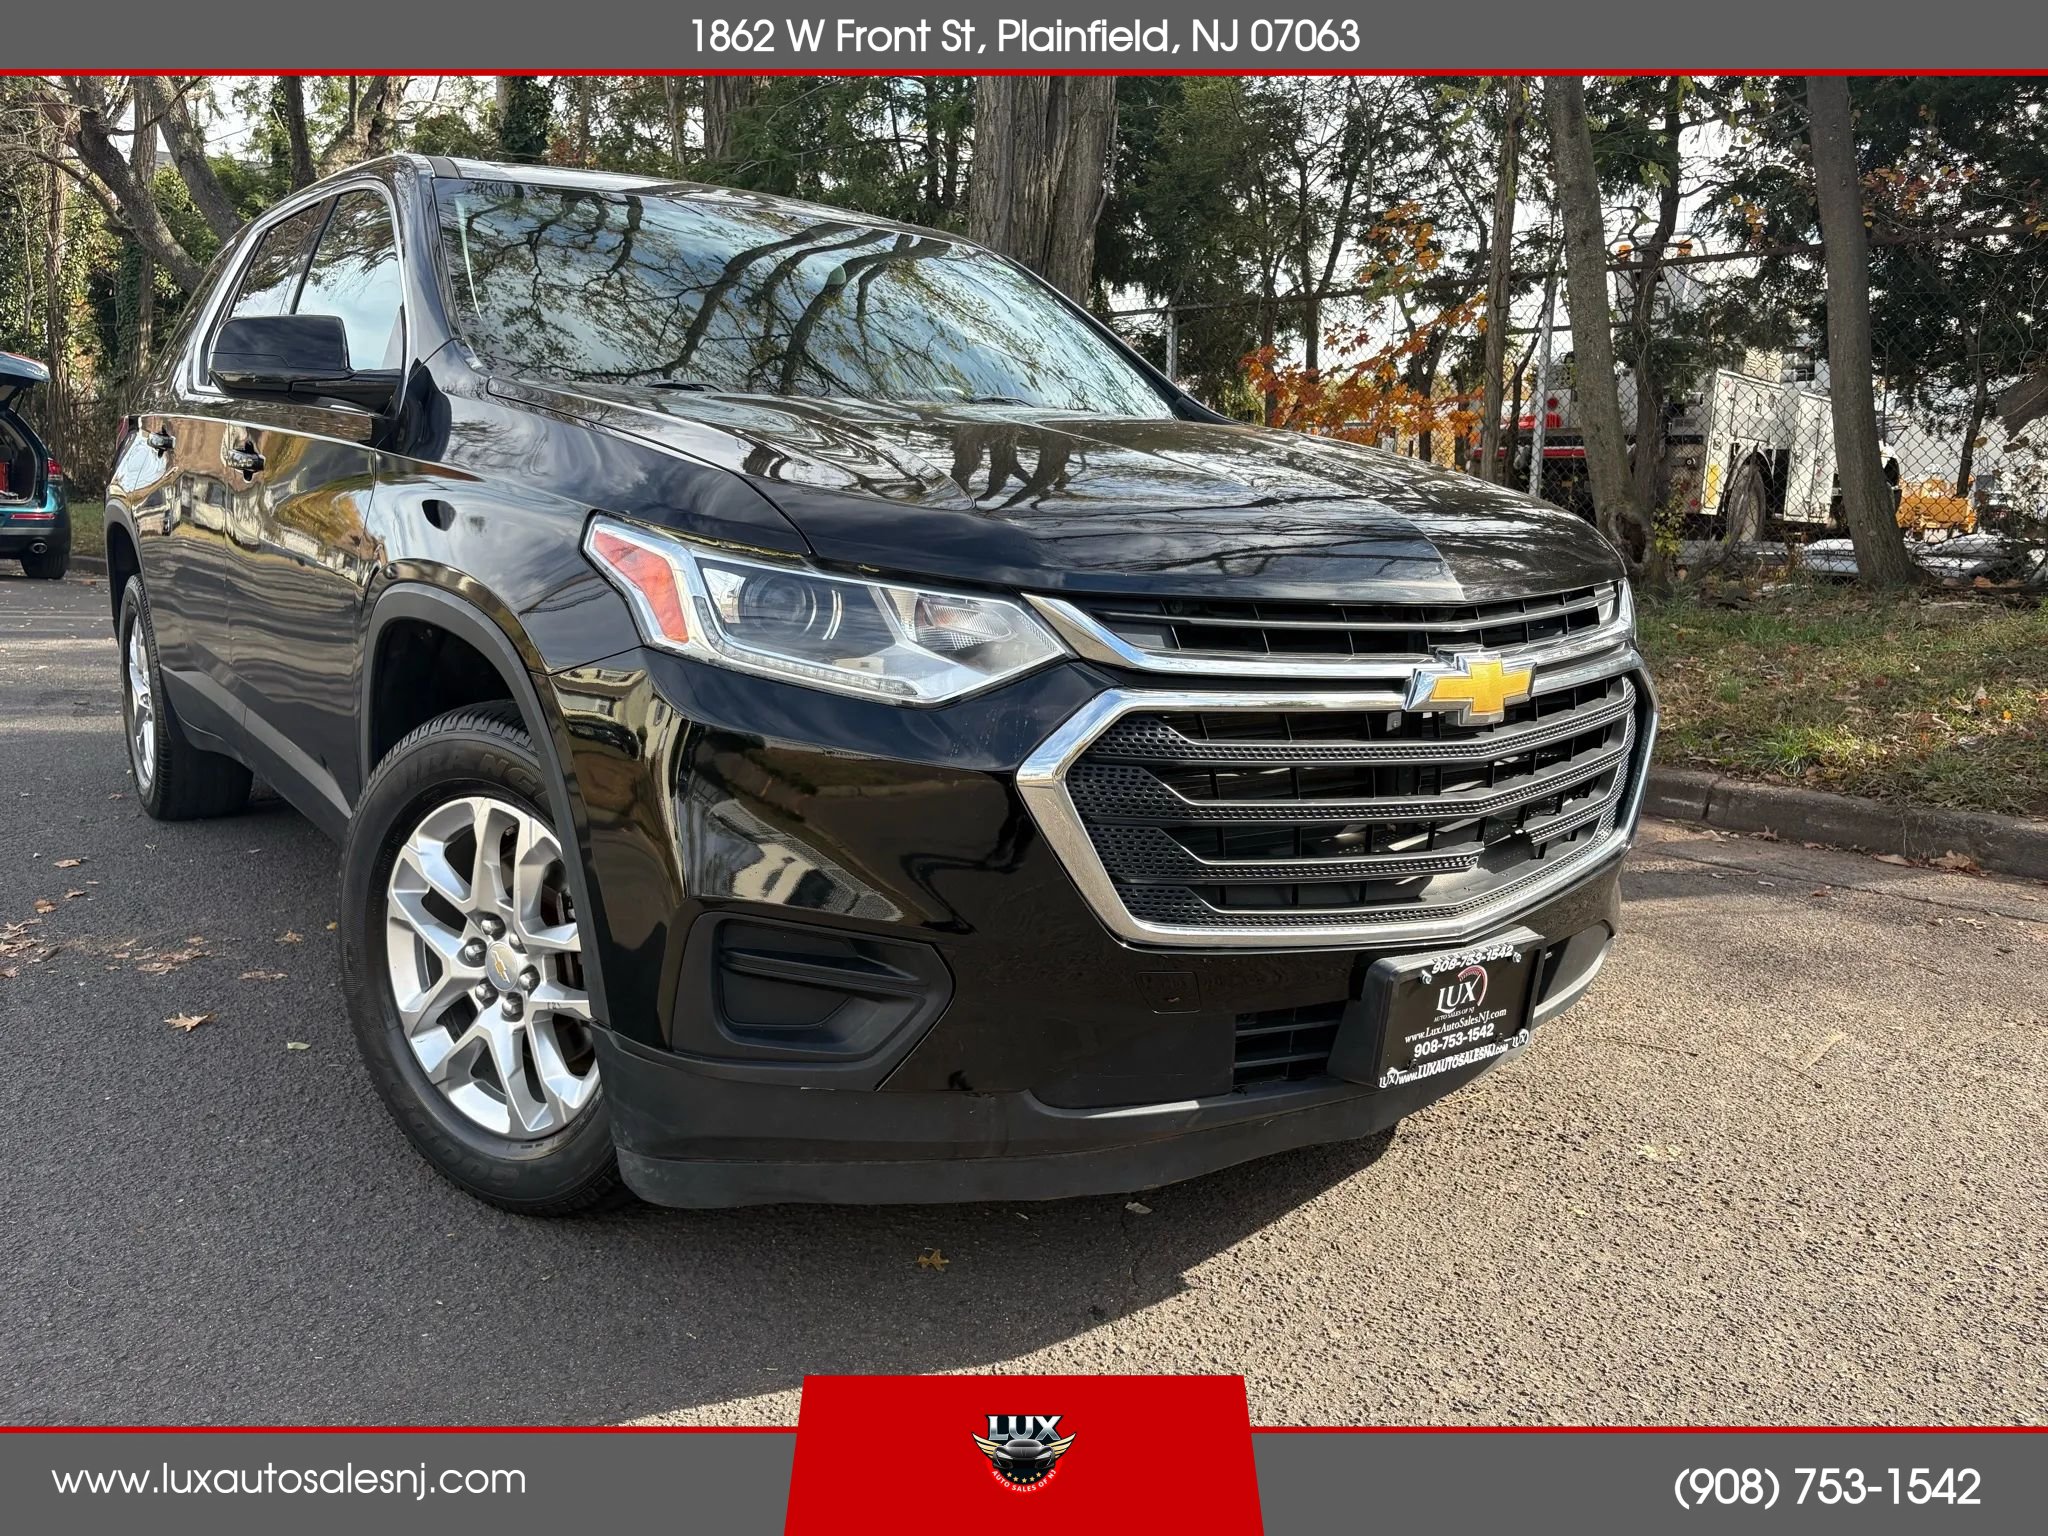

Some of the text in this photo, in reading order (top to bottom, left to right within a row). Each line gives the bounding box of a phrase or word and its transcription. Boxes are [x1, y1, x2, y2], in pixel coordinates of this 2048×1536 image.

[1432, 945, 1514, 974] 908-753-1542
[1436, 981, 1477, 1015] LUX
[1404, 1007, 1507, 1044] www.LuxAutoSalesNJ.com
[1434, 1014, 1447, 1022] AUTO
[1448, 1010, 1461, 1019] SALES
[1414, 1023, 1495, 1058] 908-753-1542
[1398, 1043, 1509, 1085] www.LUXAUTOSALESNJ.com
